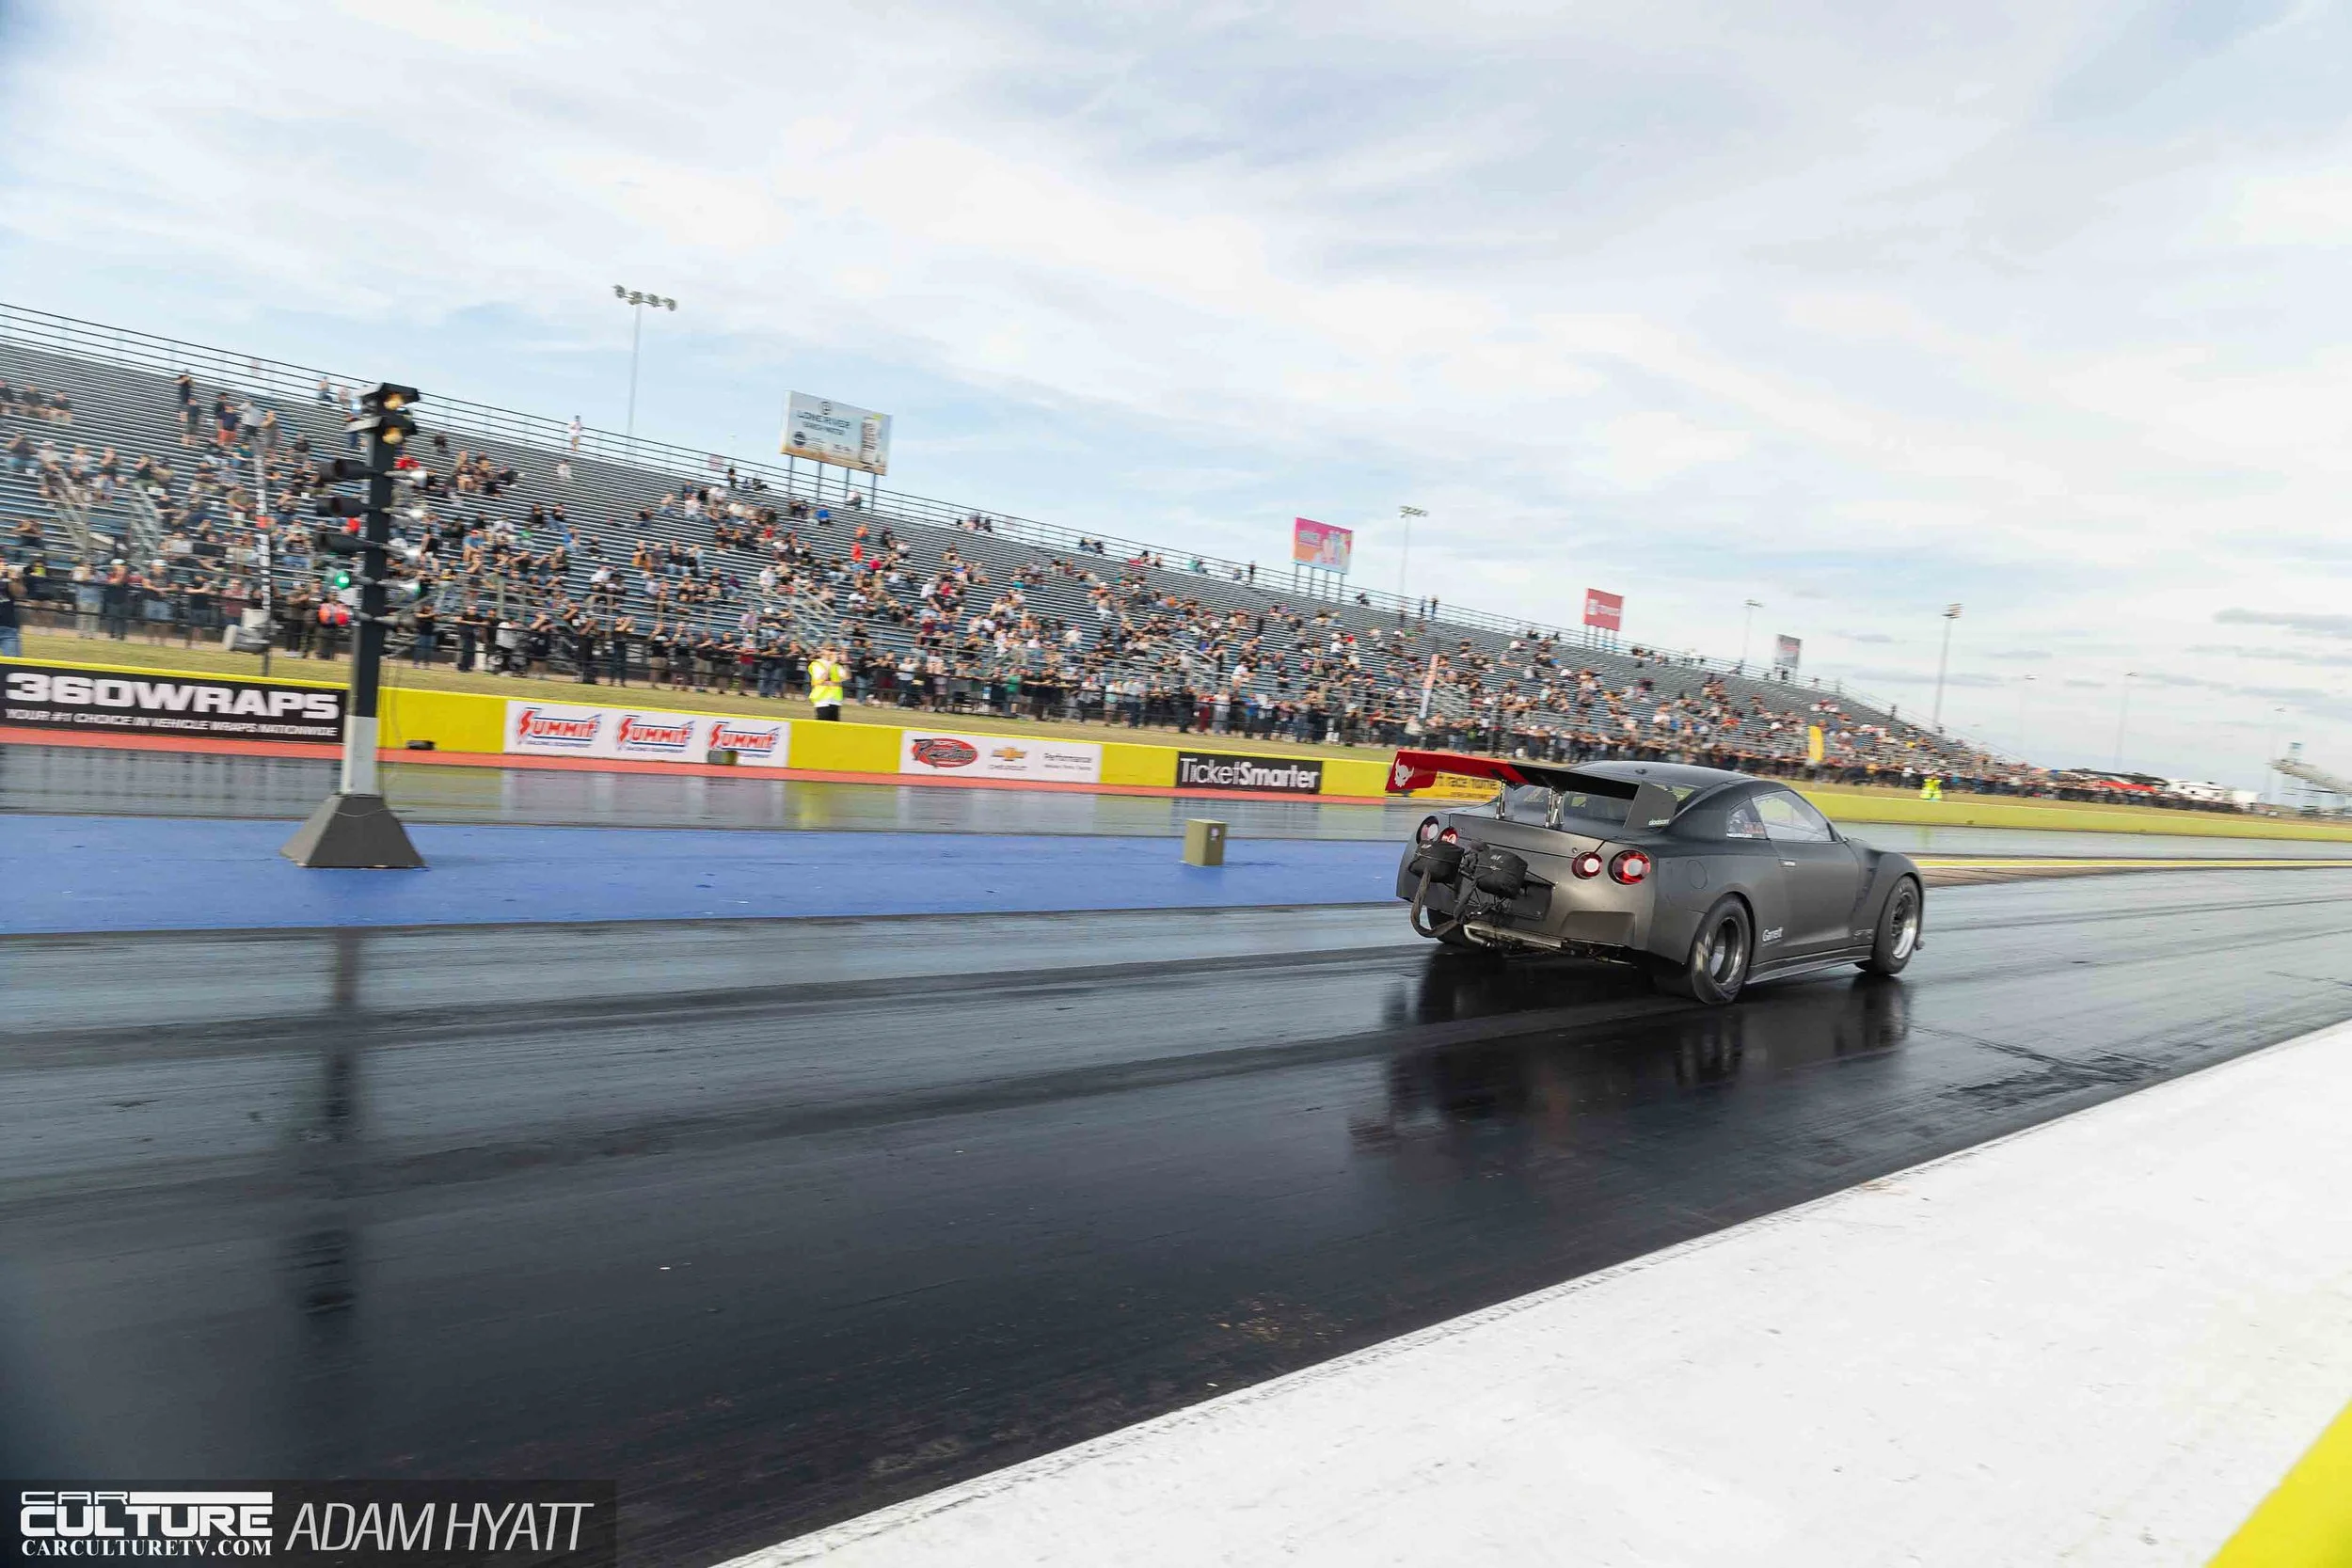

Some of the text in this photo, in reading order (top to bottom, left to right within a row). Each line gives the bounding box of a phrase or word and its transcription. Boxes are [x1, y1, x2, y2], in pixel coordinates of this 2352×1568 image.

[6, 673, 340, 720] 360WRAPS
[6, 708, 49, 721] YOUR
[73, 713, 133, 725] CHOICE
[149, 718, 209, 731] VEHICLE
[210, 721, 258, 733] WRAPS
[258, 723, 339, 736] NATIONWIDE
[1180, 757, 1320, 788] TicketSmarter
[1762, 927, 1784, 942] Garrett
